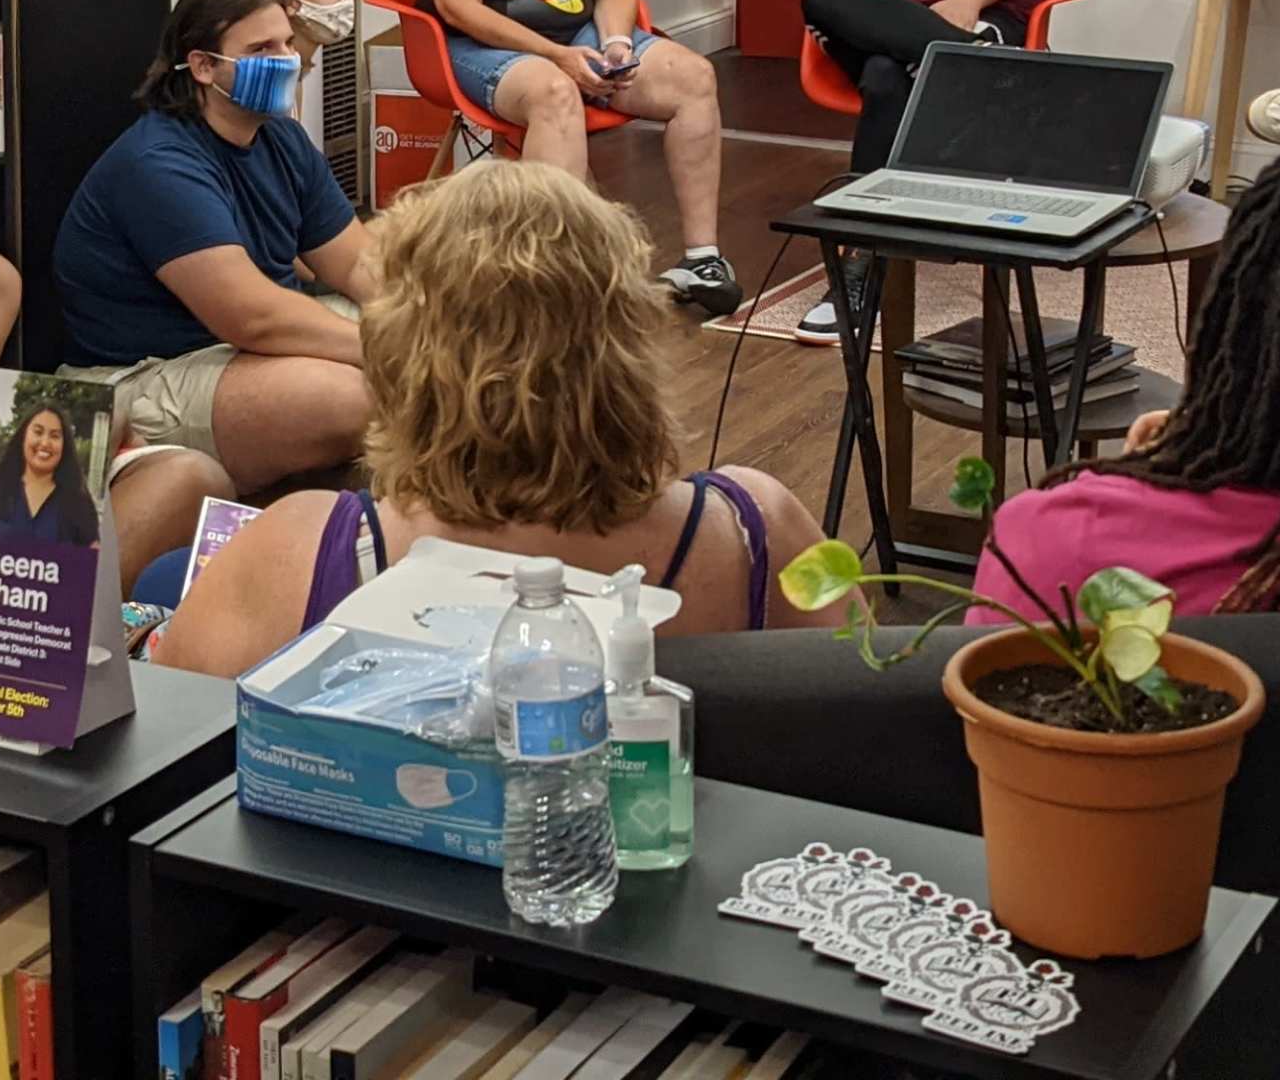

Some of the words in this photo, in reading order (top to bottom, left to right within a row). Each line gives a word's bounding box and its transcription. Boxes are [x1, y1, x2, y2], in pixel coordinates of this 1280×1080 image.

[7, 616, 33, 631] School
[34, 621, 63, 636] Teacher
[34, 635, 72, 651] Democrat
[11, 644, 38, 659] District
[4, 656, 22, 668] Side
[5, 688, 50, 708] Election:
[6, 702, 24, 718] 5th
[291, 757, 317, 776] Face
[319, 763, 356, 783] Masks
[608, 757, 648, 771] itizer
